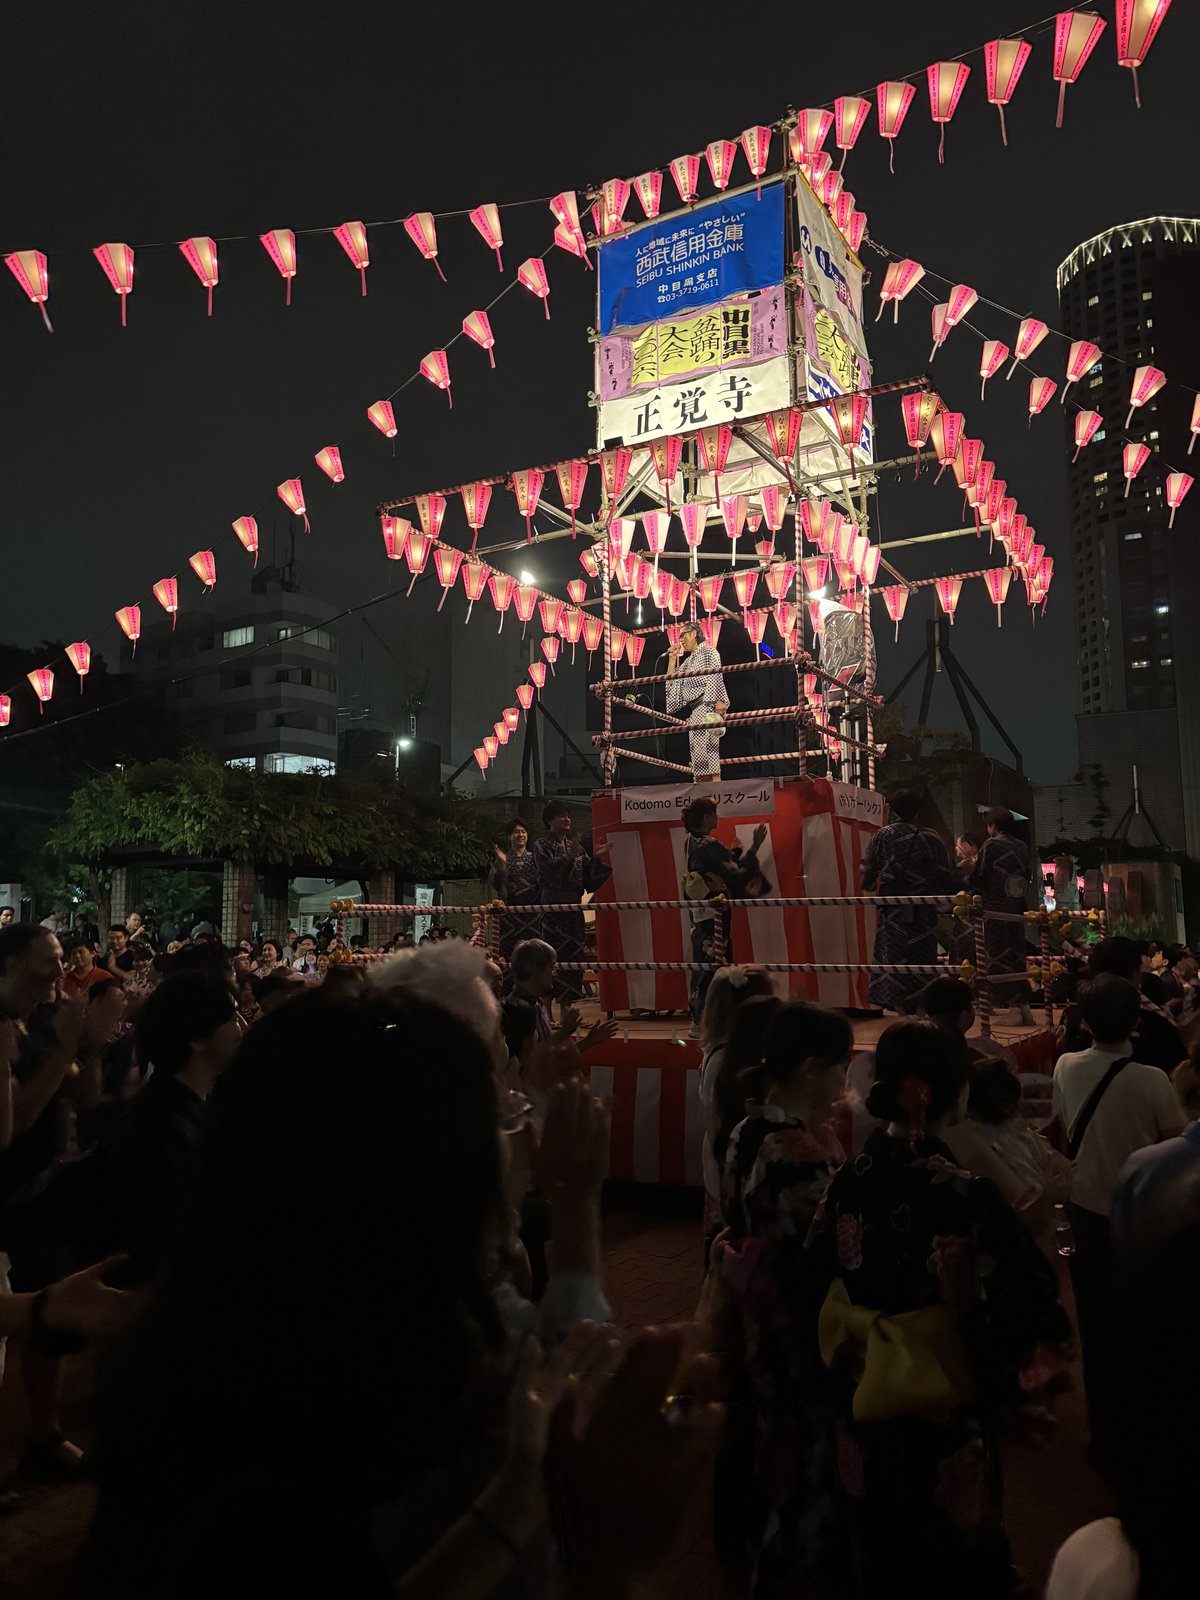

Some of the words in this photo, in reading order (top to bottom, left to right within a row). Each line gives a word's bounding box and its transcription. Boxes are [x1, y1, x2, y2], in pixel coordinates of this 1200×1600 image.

[636, 223, 744, 277] 西武信用金庫
[636, 267, 663, 288] SEIBU
[666, 252, 710, 276] SHINKIN
[713, 243, 744, 260] BANK
[658, 268, 718, 294] 中目黒支店
[659, 326, 689, 363] 大会
[722, 309, 750, 360] 中目黒
[631, 375, 753, 437] 正覚寺
[624, 798, 671, 812] Kodomo
[675, 795, 693, 809] Ed
